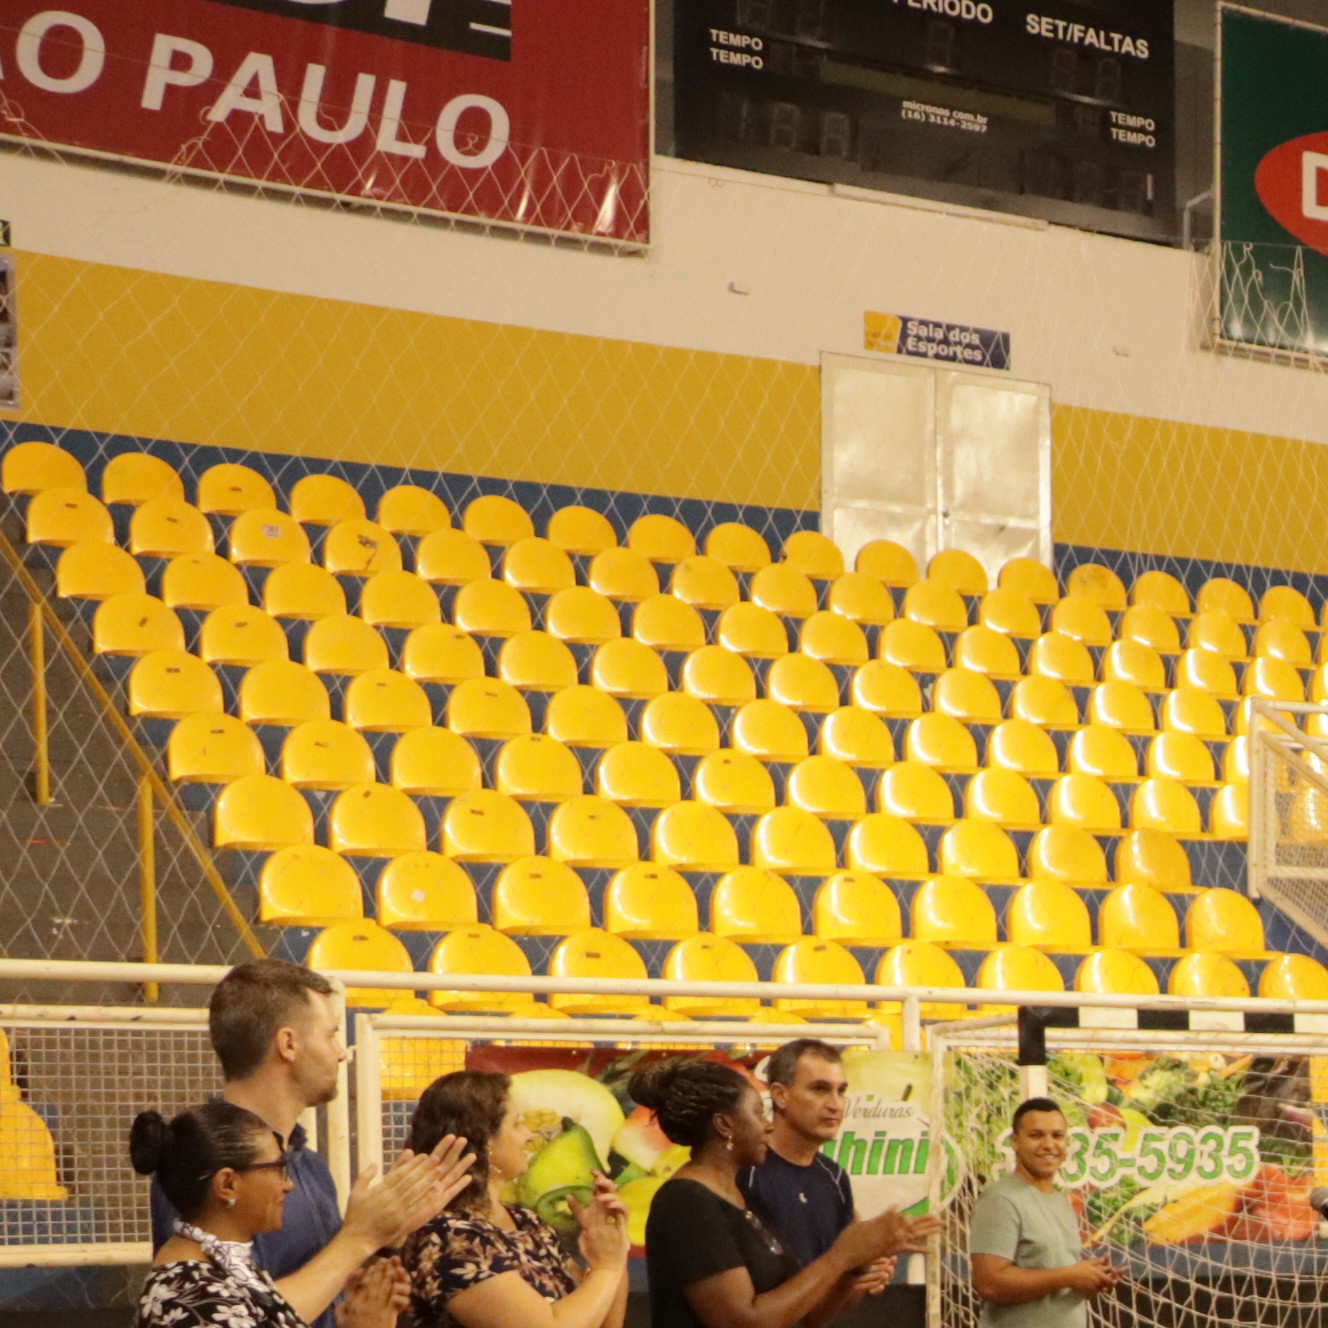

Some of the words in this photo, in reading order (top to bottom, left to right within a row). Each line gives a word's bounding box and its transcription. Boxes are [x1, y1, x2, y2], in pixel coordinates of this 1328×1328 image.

[710, 28, 763, 51] TEMPO
[1026, 14, 1149, 59] SET/FALTAS
[710, 47, 764, 70] TEMPO
[141, 33, 510, 169] PAULO
[1110, 111, 1155, 131] TEMPO
[1111, 129, 1156, 148] TEMPO
[907, 319, 945, 339] Sala
[949, 326, 980, 345] dos
[907, 337, 983, 361] Esportes
